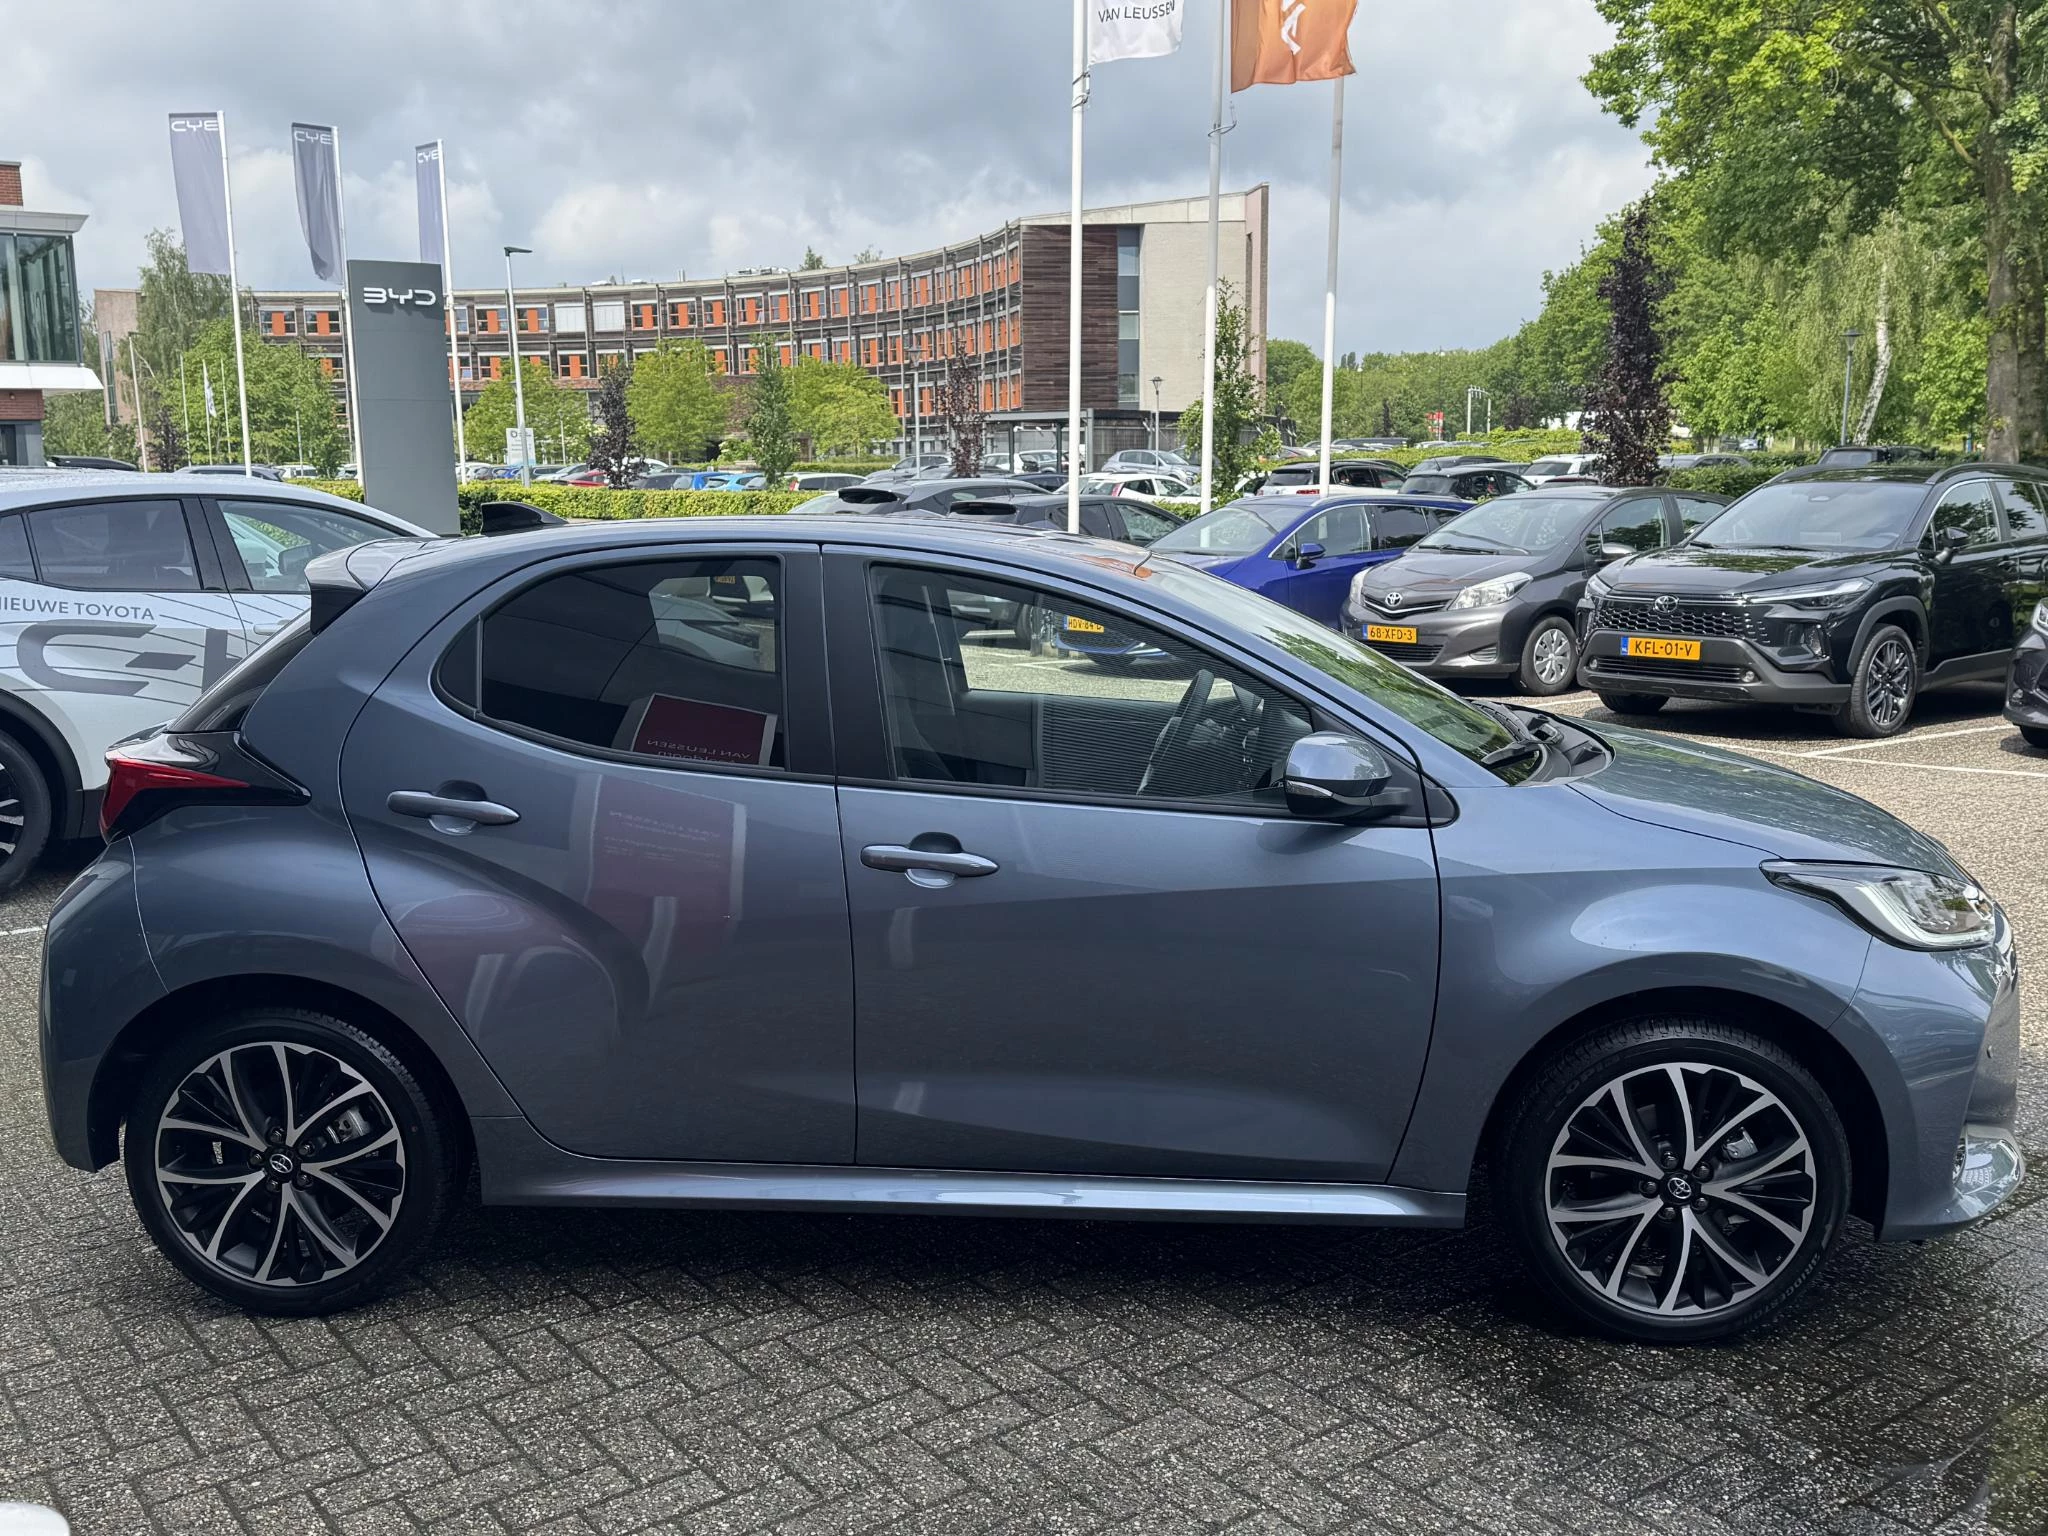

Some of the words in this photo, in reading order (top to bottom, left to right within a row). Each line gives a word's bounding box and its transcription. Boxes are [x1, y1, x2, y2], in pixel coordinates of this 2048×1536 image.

[1098, 7, 1120, 23] VAN
[1123, 0, 1175, 20] LEUSSEN
[363, 287, 437, 306] BYD
[0, 596, 69, 614] IEUWE
[74, 602, 155, 621] TOYOTA
[1370, 627, 1413, 641] 68-XFD-3
[1635, 640, 1693, 657] KFL-01-V
